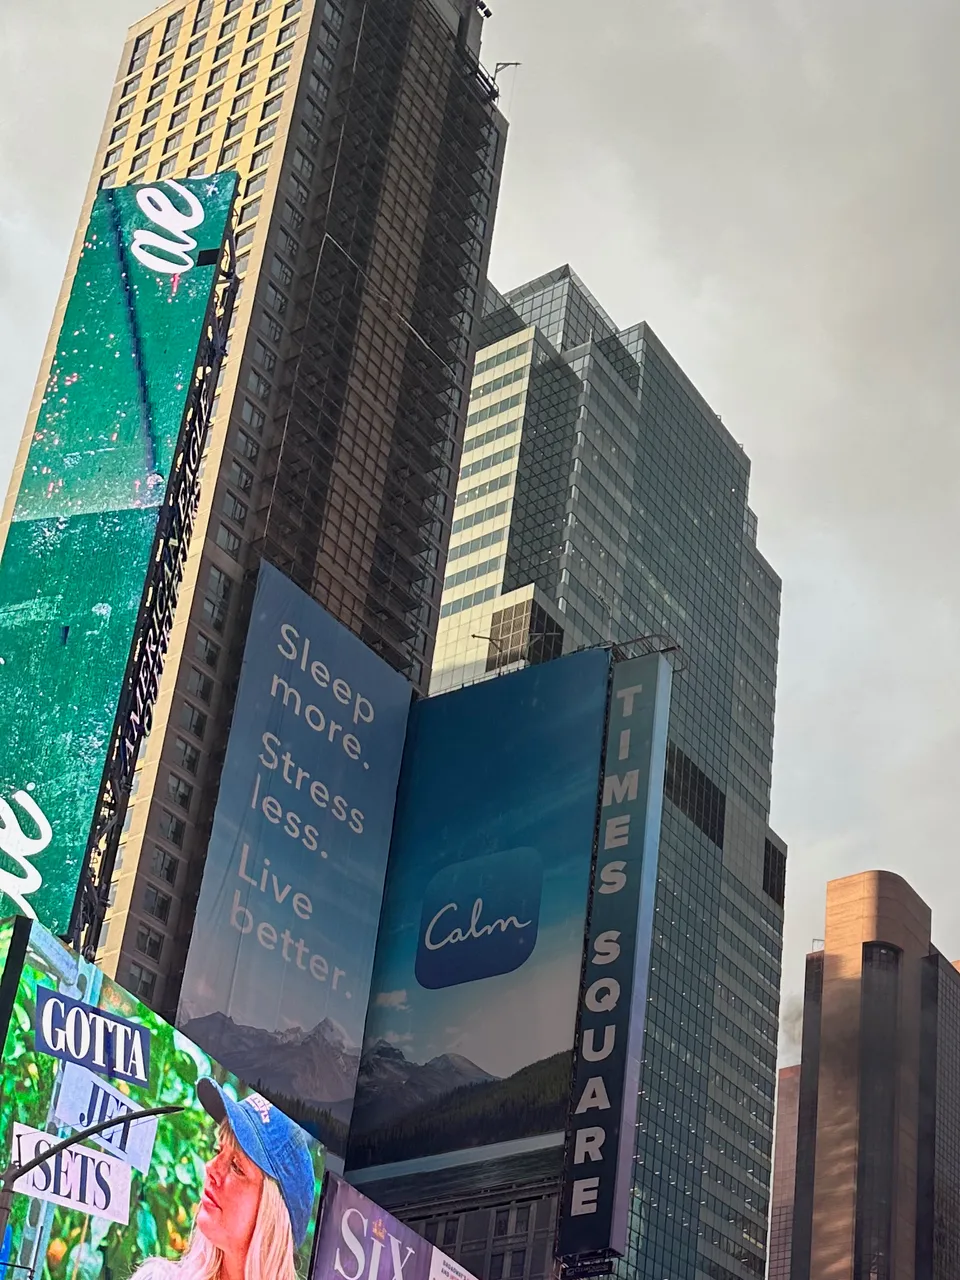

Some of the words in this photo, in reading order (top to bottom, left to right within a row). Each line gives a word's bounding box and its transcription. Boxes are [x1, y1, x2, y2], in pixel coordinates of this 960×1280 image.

[277, 623, 375, 724] Sleep
[269, 673, 370, 771] more.
[250, 772, 329, 859] less.
[258, 731, 365, 834] Stress
[596, 683, 643, 895] TIMES
[238, 843, 313, 920] Live
[424, 898, 533, 951] Calm
[229, 889, 353, 999] better.
[41, 996, 148, 1083] GOTTA
[570, 930, 623, 1217] SQUARE
[79, 1080, 134, 1155] JET
[31, 1139, 112, 1211] SETS
